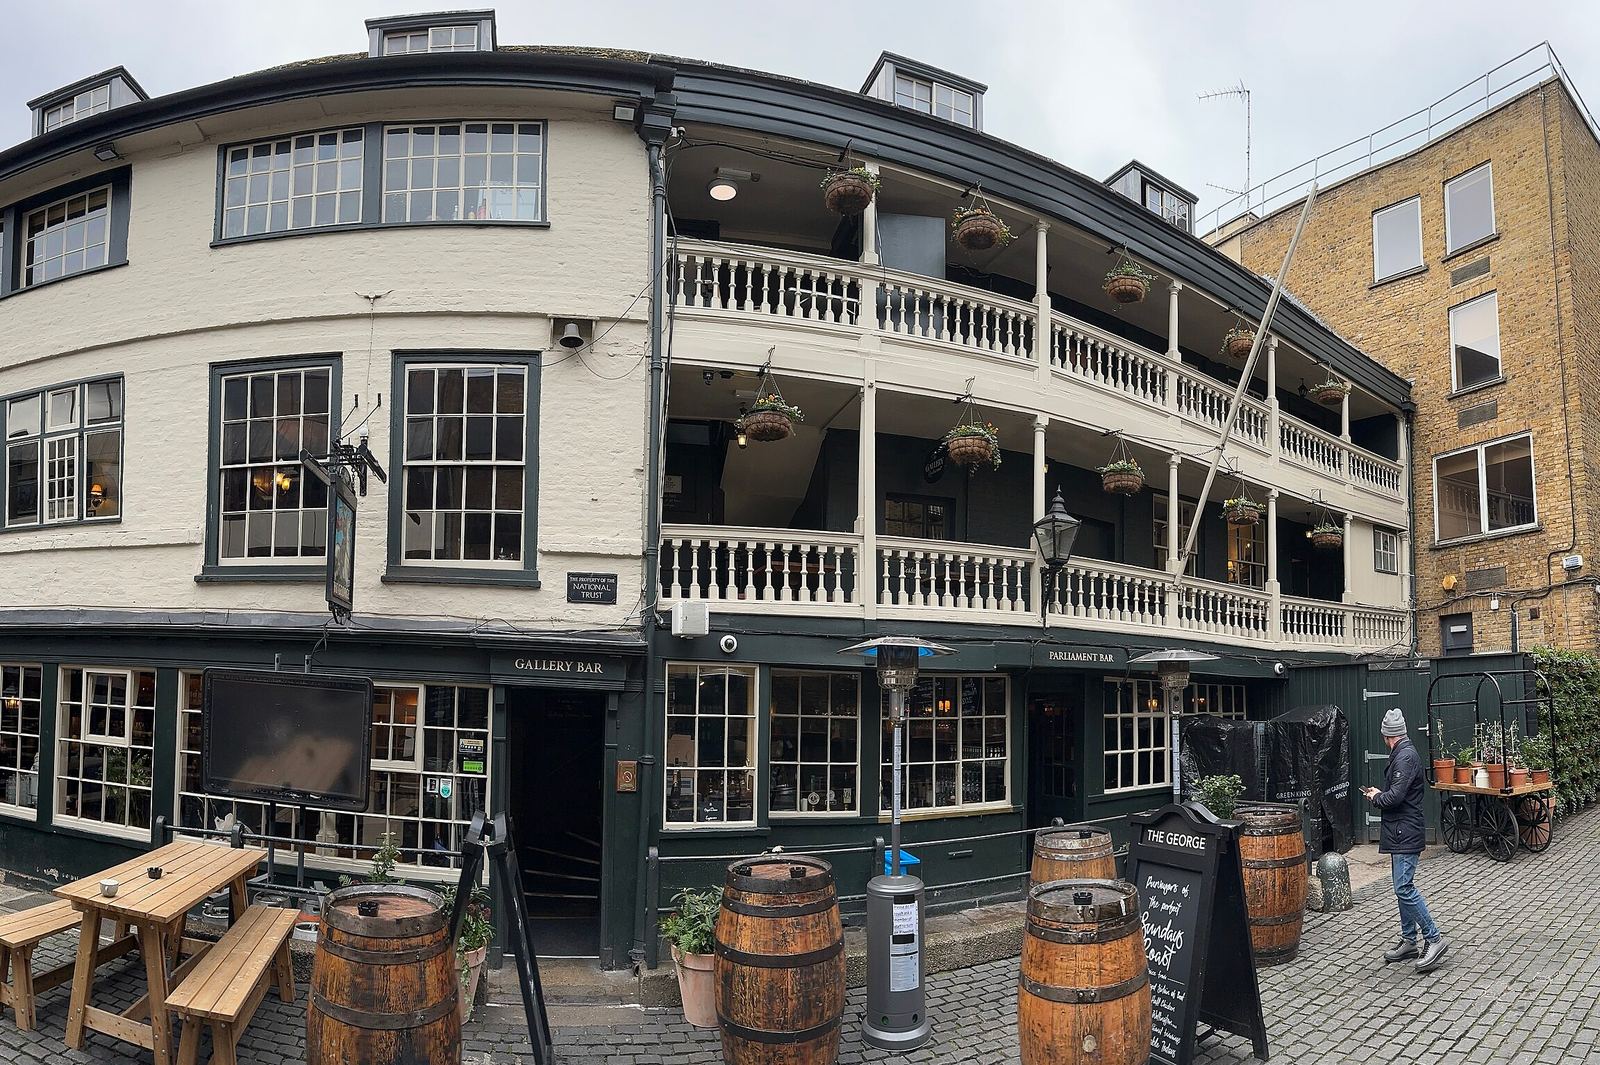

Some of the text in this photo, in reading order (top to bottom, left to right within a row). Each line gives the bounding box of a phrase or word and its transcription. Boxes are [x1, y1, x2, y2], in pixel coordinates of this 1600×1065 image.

[573, 583, 611, 591] NATIONAL
[581, 591, 603, 599] TRUST
[1049, 651, 1114, 662] PARLIAMENT BAR
[515, 659, 603, 674] GALLERY BAR
[1147, 829, 1206, 850] THE GEORGE
[1149, 895, 1182, 916] the perfect
